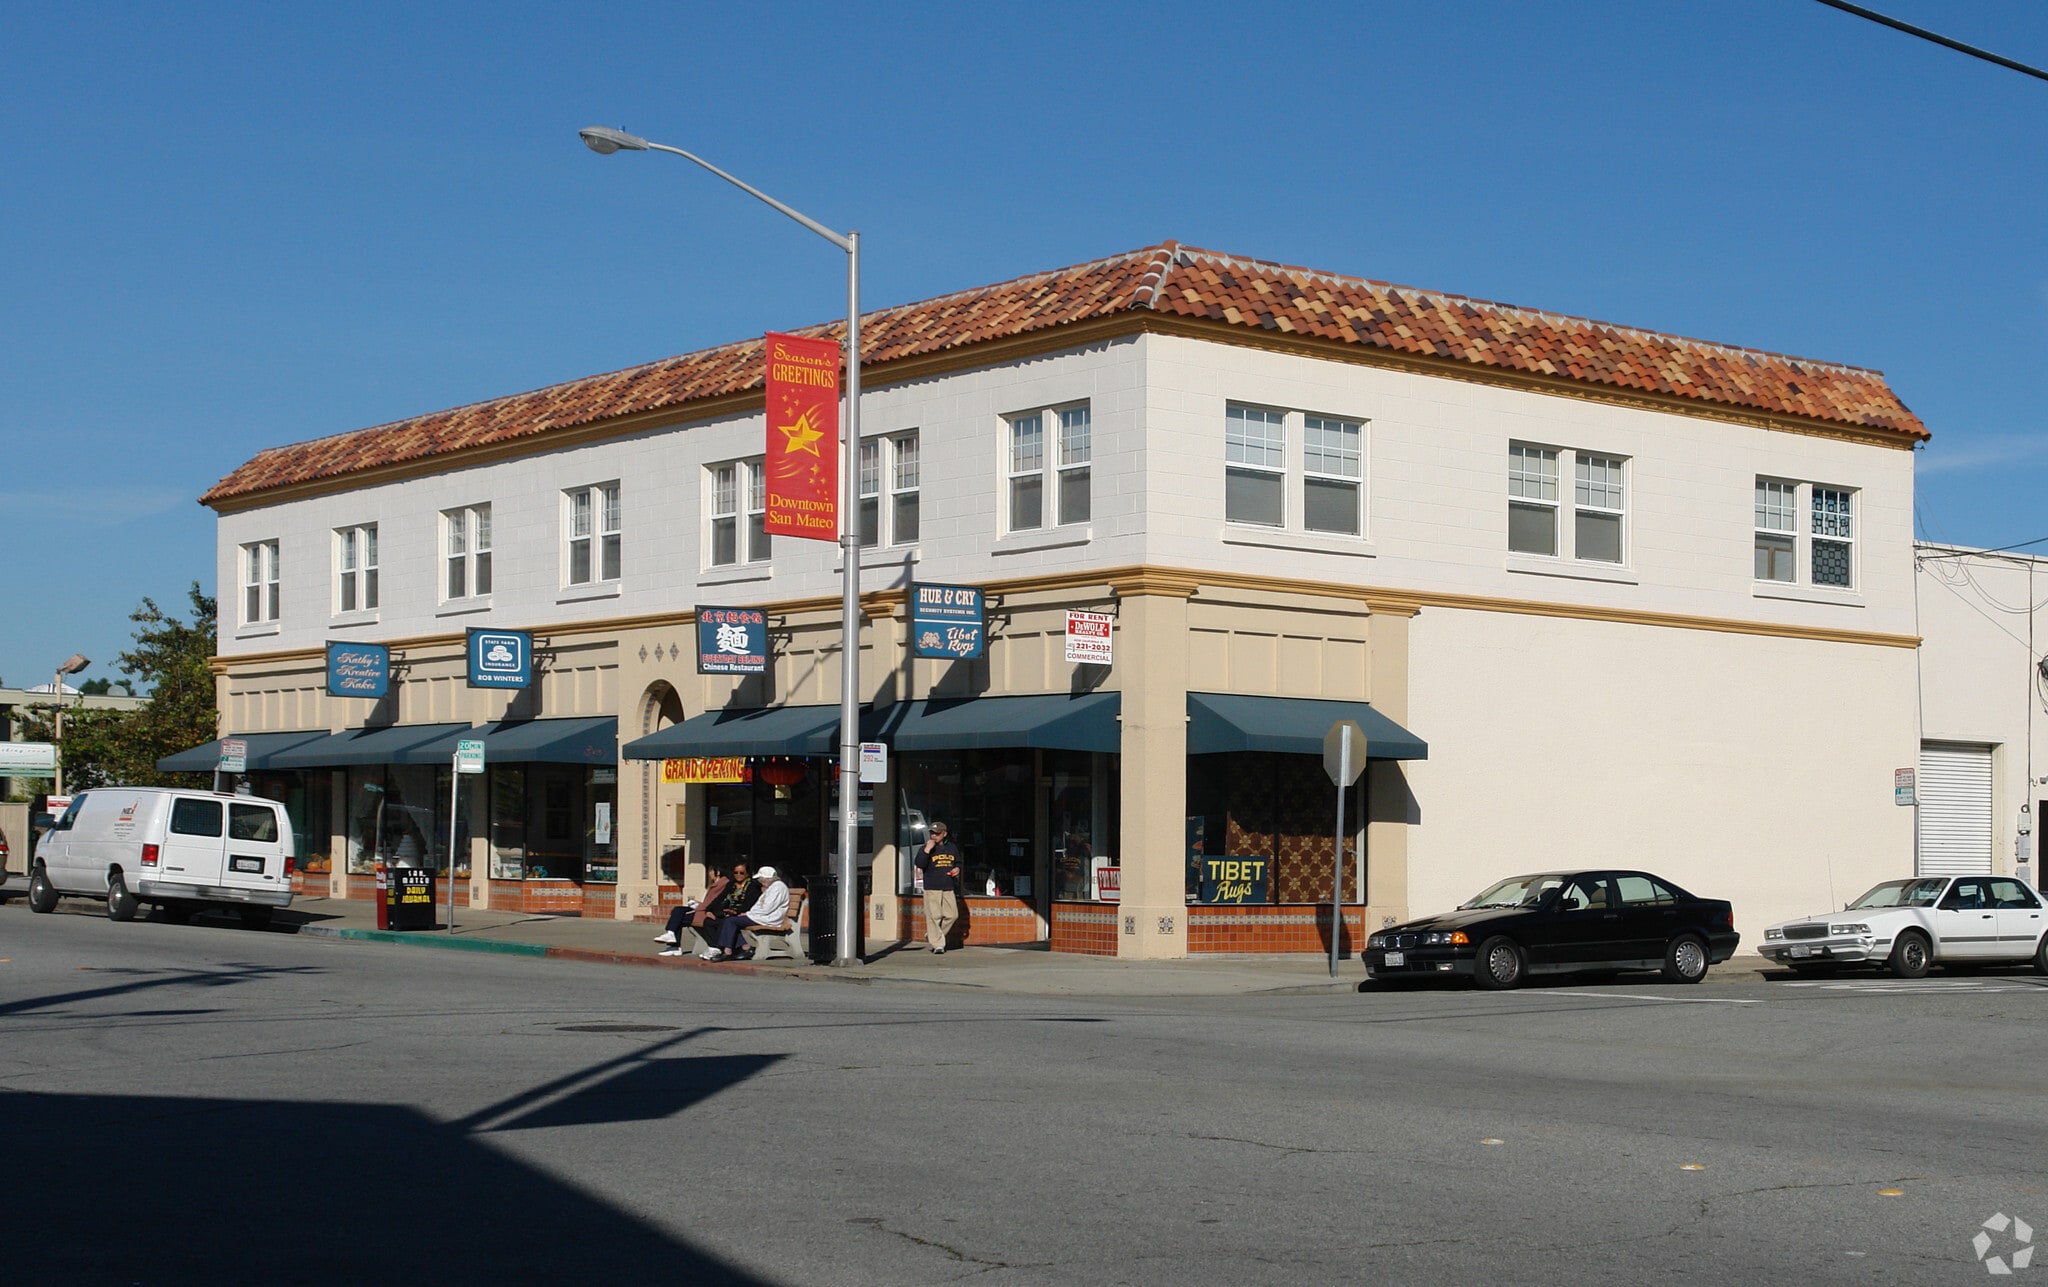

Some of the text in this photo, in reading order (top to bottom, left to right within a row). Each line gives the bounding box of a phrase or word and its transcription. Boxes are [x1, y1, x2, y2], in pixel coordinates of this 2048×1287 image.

[774, 342, 834, 367] Season's
[772, 364, 834, 388] GREETINGS
[770, 493, 834, 513] Downtown
[768, 510, 834, 529] San Mateo
[920, 588, 976, 606] HUE & CRY
[946, 626, 978, 641] Tibet
[948, 640, 975, 657] Rugs
[1076, 643, 1110, 651] 221-2032
[336, 652, 380, 668] Kathy's
[703, 654, 765, 664] EVERYDAY BEIJING
[1067, 653, 1110, 662] COMMERCIAL
[336, 664, 381, 677] Kreative
[340, 677, 376, 689] Kakes
[666, 758, 697, 780] GRAND
[700, 757, 744, 779] OPENING
[1208, 860, 1264, 880] TIBET
[1098, 870, 1109, 888] FOR
[402, 895, 431, 903] JOURNAL
[1211, 880, 1252, 904] Rugs
